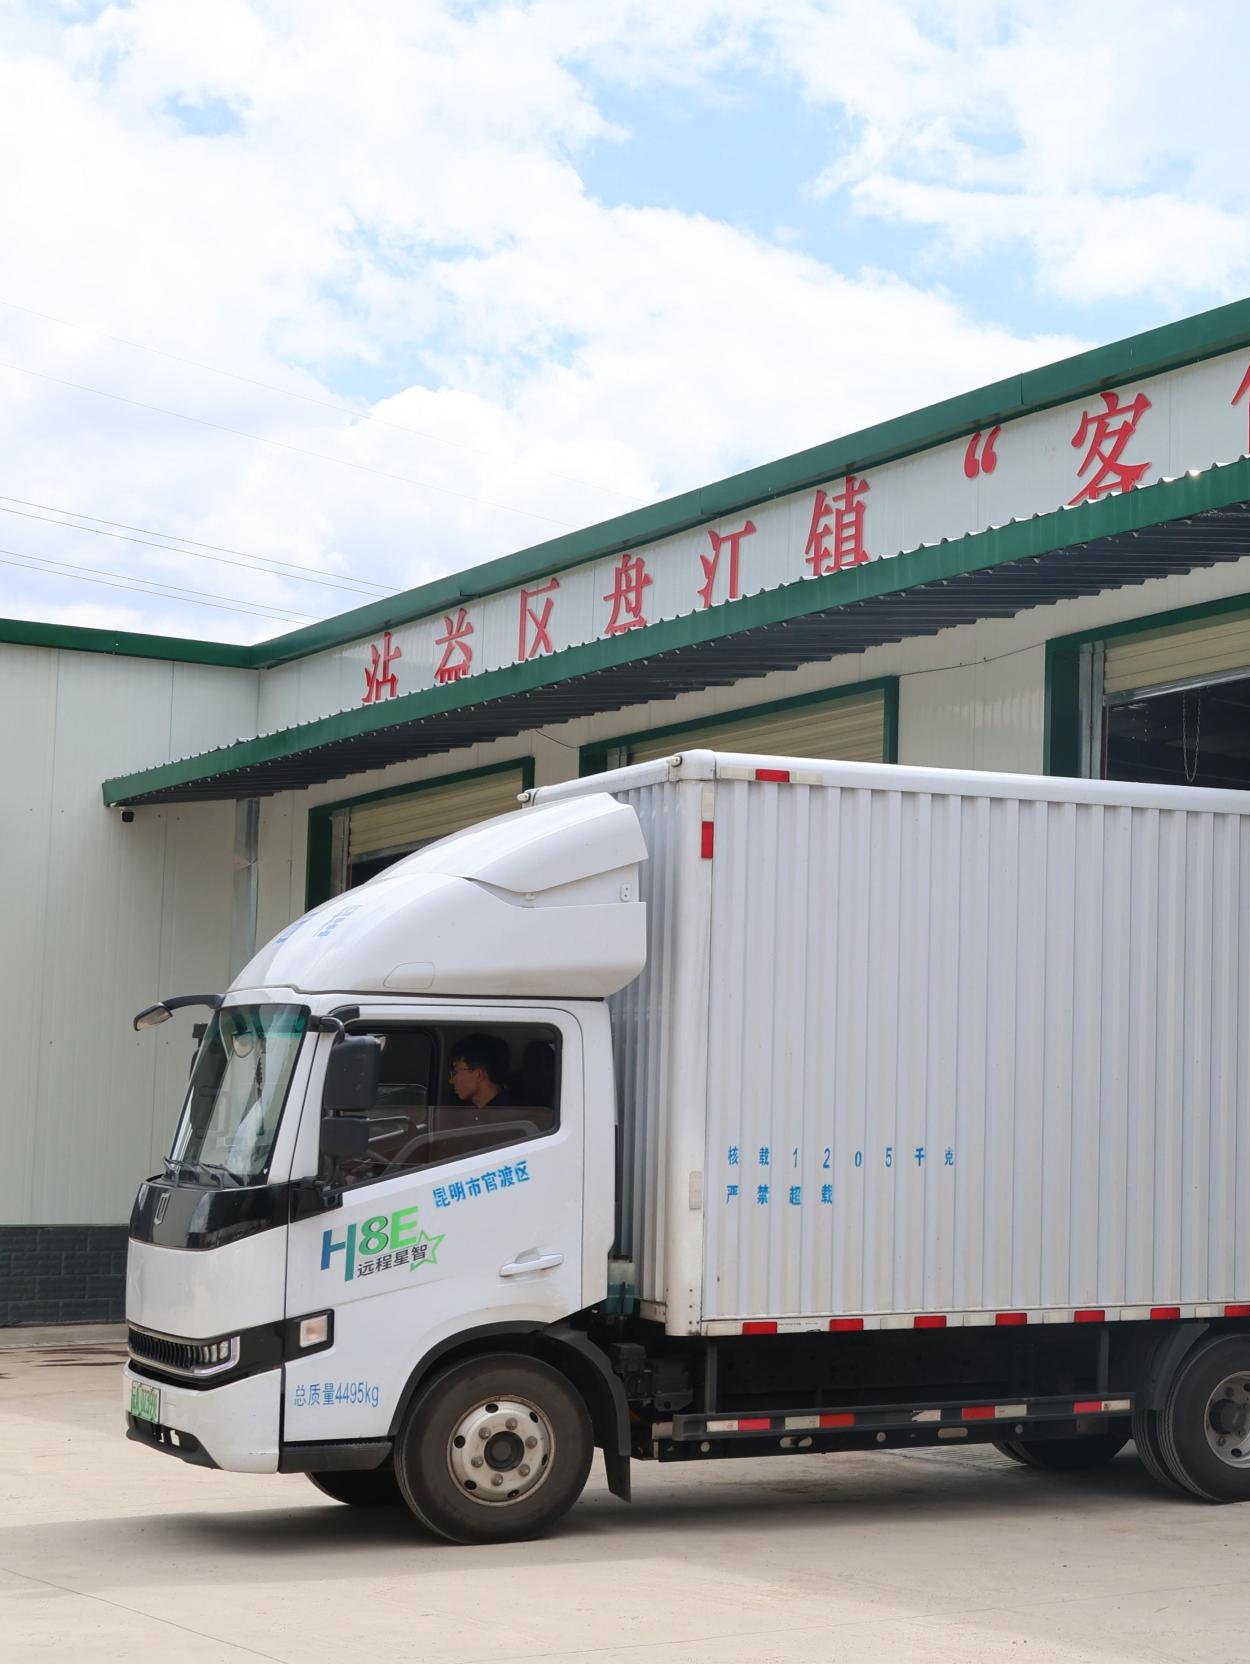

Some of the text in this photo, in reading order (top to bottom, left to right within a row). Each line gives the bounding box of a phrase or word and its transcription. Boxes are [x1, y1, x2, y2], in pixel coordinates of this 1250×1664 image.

[432, 1160, 531, 1209] 昆明市官渡区
[725, 1183, 834, 1206] 严禁超载
[320, 1206, 419, 1282] H8E
[356, 1244, 428, 1278] 远程星智
[294, 1381, 380, 1408] 总质量4495kg
